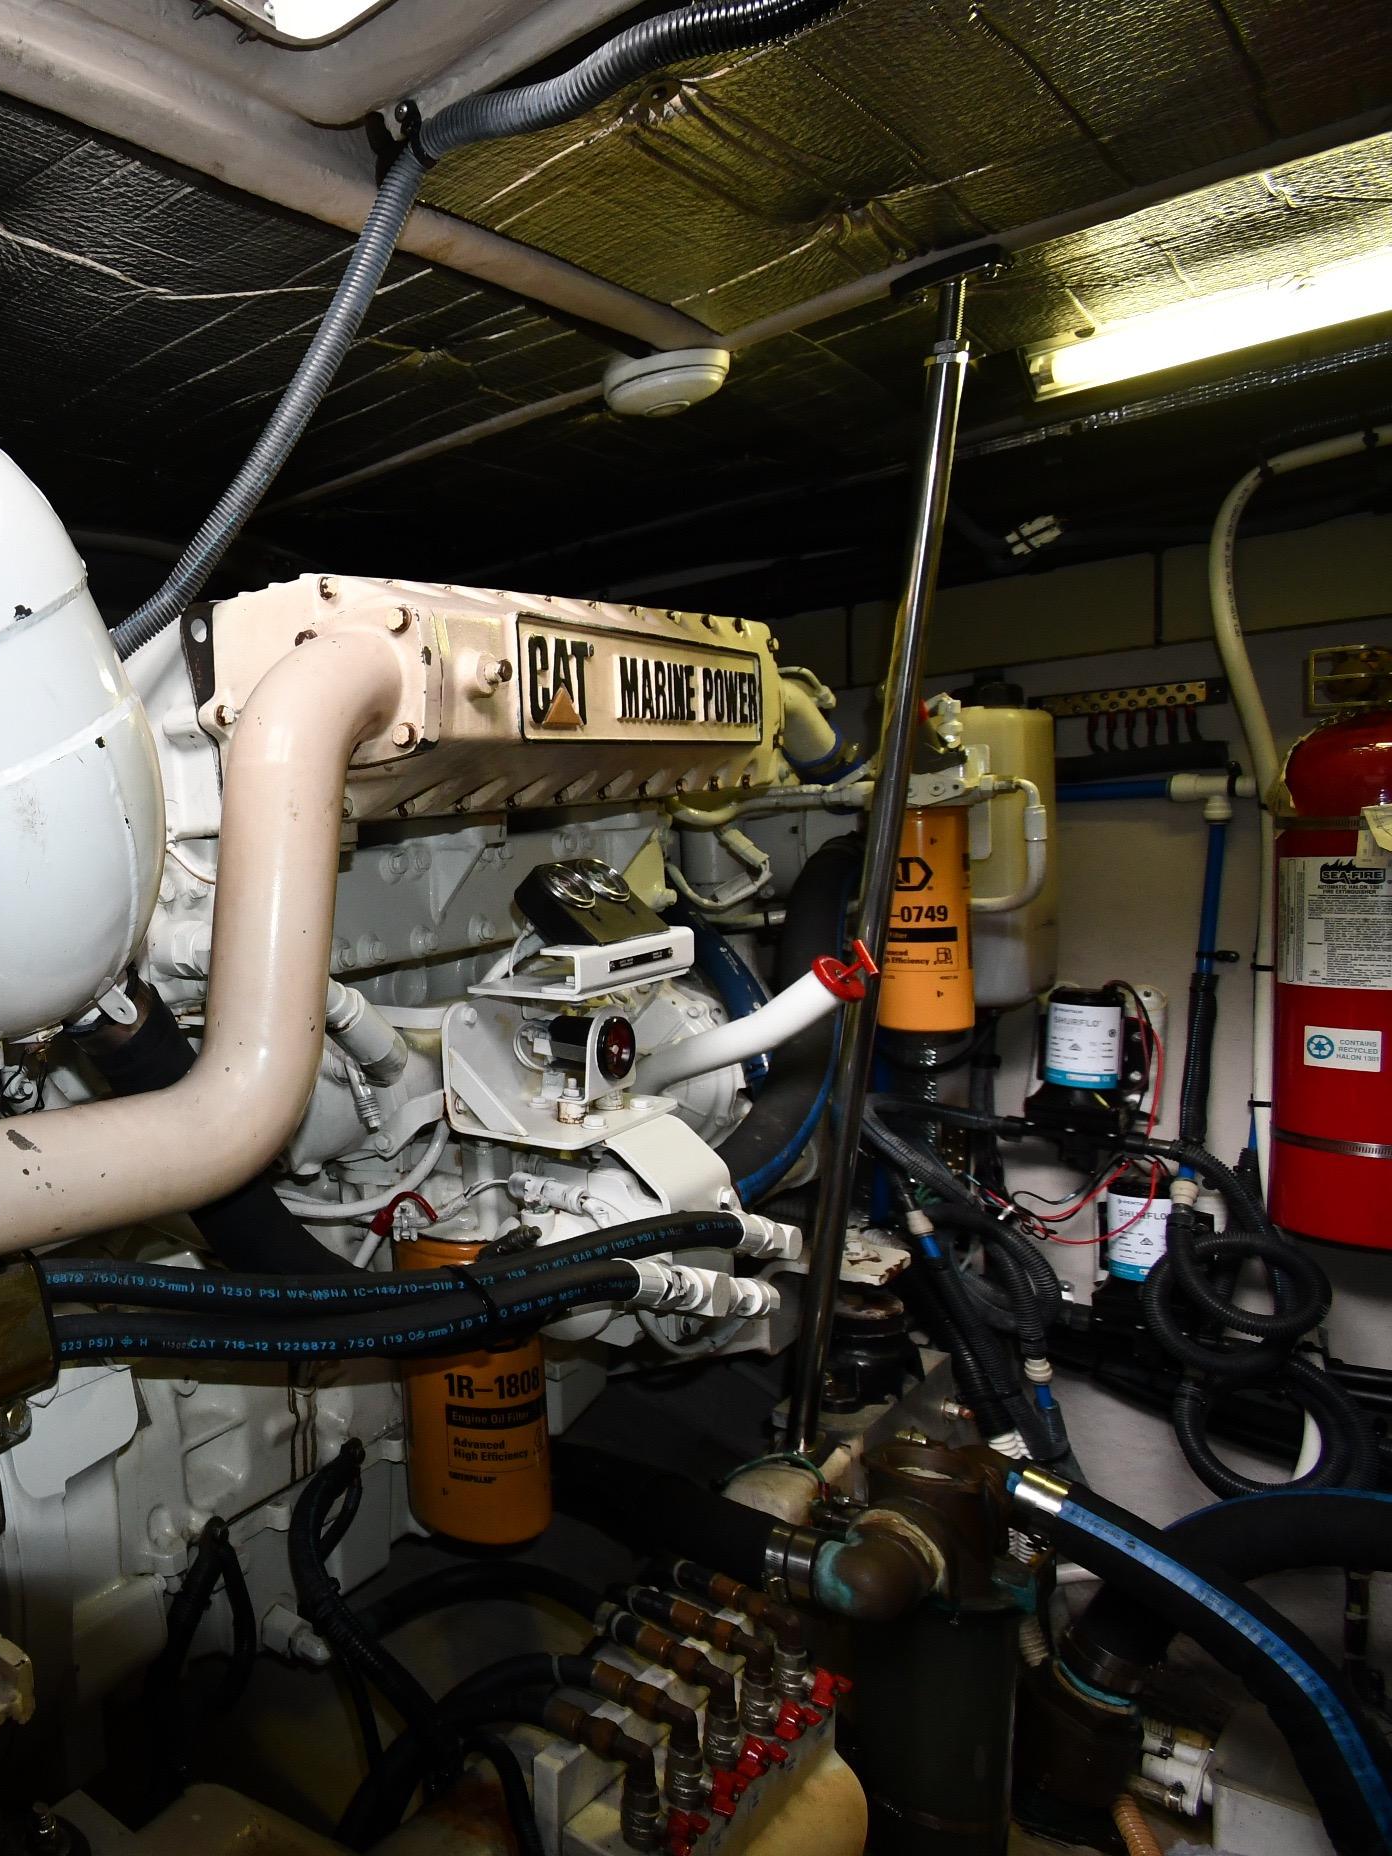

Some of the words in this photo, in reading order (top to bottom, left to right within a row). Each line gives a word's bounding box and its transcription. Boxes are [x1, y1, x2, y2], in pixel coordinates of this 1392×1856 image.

[528, 635, 587, 725] CAT
[619, 656, 696, 721] MARINE
[702, 667, 758, 724] POWER
[891, 905, 948, 922] -0749
[1338, 1046, 1379, 1055] RECYCLED
[1339, 1039, 1377, 1048] CONTAINS
[1336, 1053, 1362, 1061] HALON
[1118, 1209, 1167, 1220] SHFLO
[202, 1284, 216, 1295] ID
[221, 1284, 252, 1298] 1250
[259, 1288, 280, 1299] PSI
[572, 1252, 593, 1264] BAR
[191, 1338, 216, 1349] CAT
[224, 1339, 269, 1351] 716-12
[513, 1301, 532, 1314] PSI
[60, 1341, 82, 1352] 523
[88, 1336, 115, 1349] PSI)
[444, 1366, 541, 1400] 1R-1808
[451, 1411, 487, 1425] Engine
[490, 1413, 505, 1424] Oil
[453, 1437, 505, 1450] Advanced
[453, 1449, 478, 1462] High
[481, 1449, 529, 1462] Efficiency
